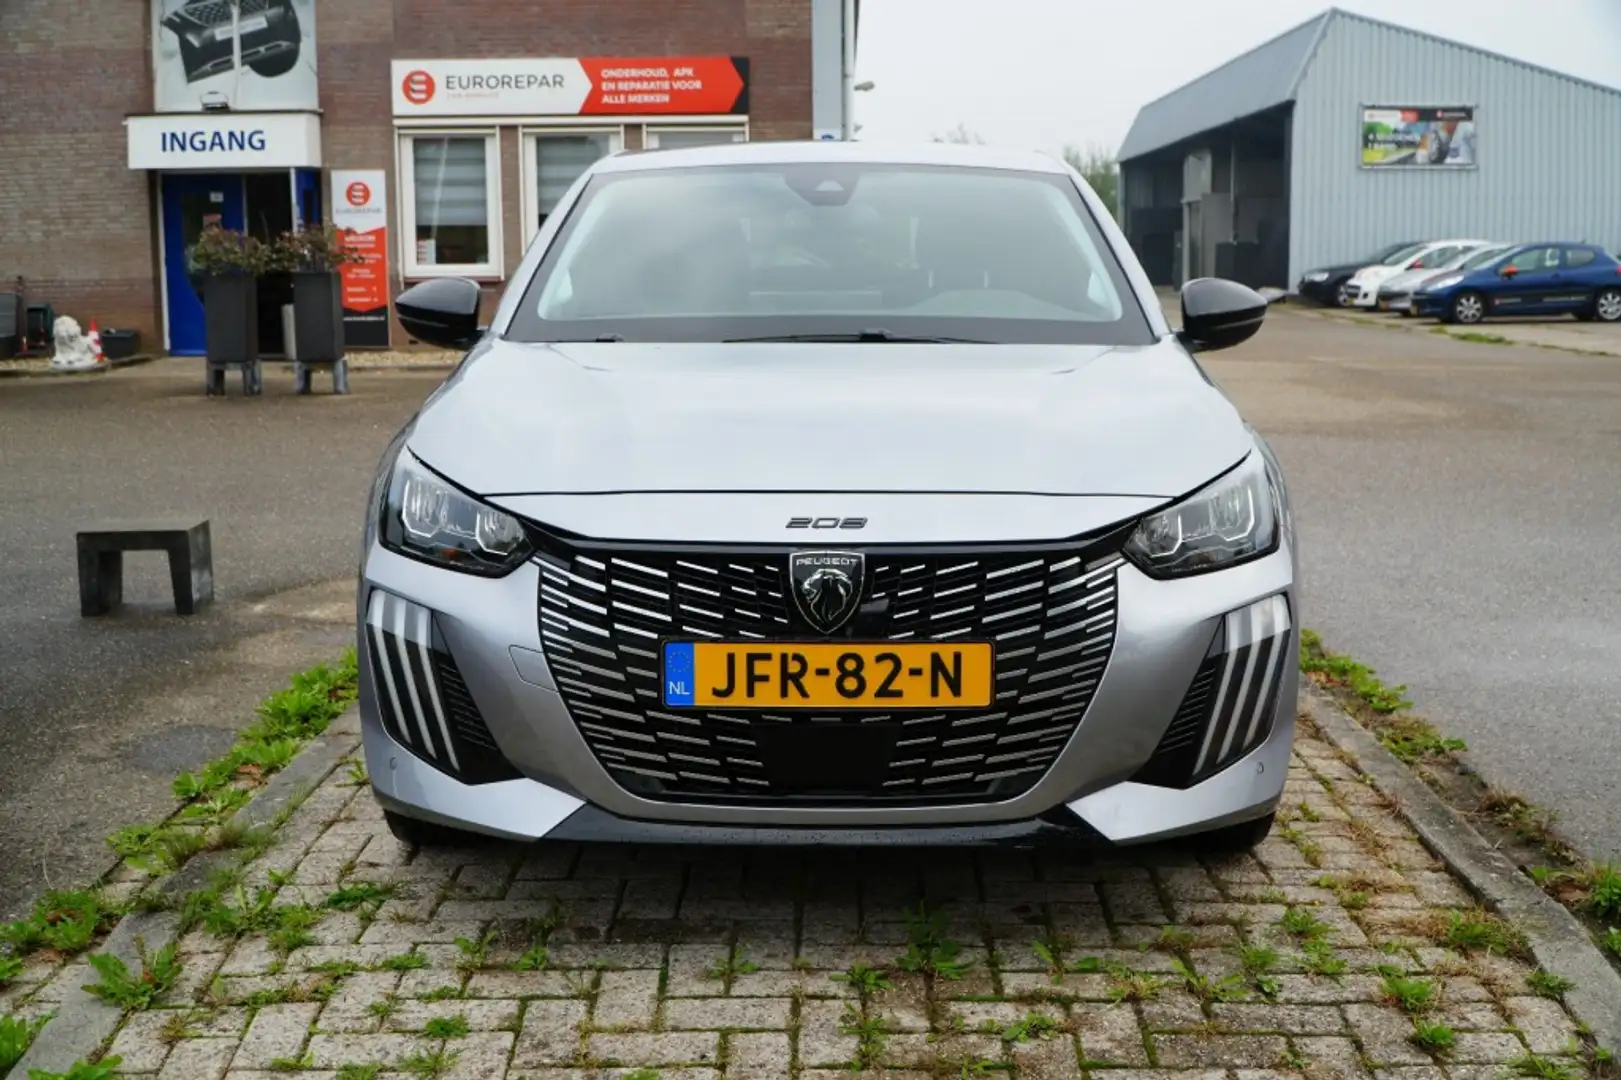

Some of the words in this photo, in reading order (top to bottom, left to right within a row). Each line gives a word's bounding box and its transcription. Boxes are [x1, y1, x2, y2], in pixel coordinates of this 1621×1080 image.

[674, 67, 694, 77] APK
[445, 74, 565, 90] EUROREPAR
[601, 81, 616, 91] EN
[617, 80, 670, 91] REPARATIE
[671, 79, 702, 90] VOOR
[601, 94, 626, 104] ALLE
[627, 93, 670, 103] MERKEN
[161, 130, 266, 152] INGANG
[785, 517, 868, 529] 208
[796, 557, 858, 566] PEUGEOT
[668, 681, 690, 696] NL
[711, 651, 963, 699] JFR-82-N
